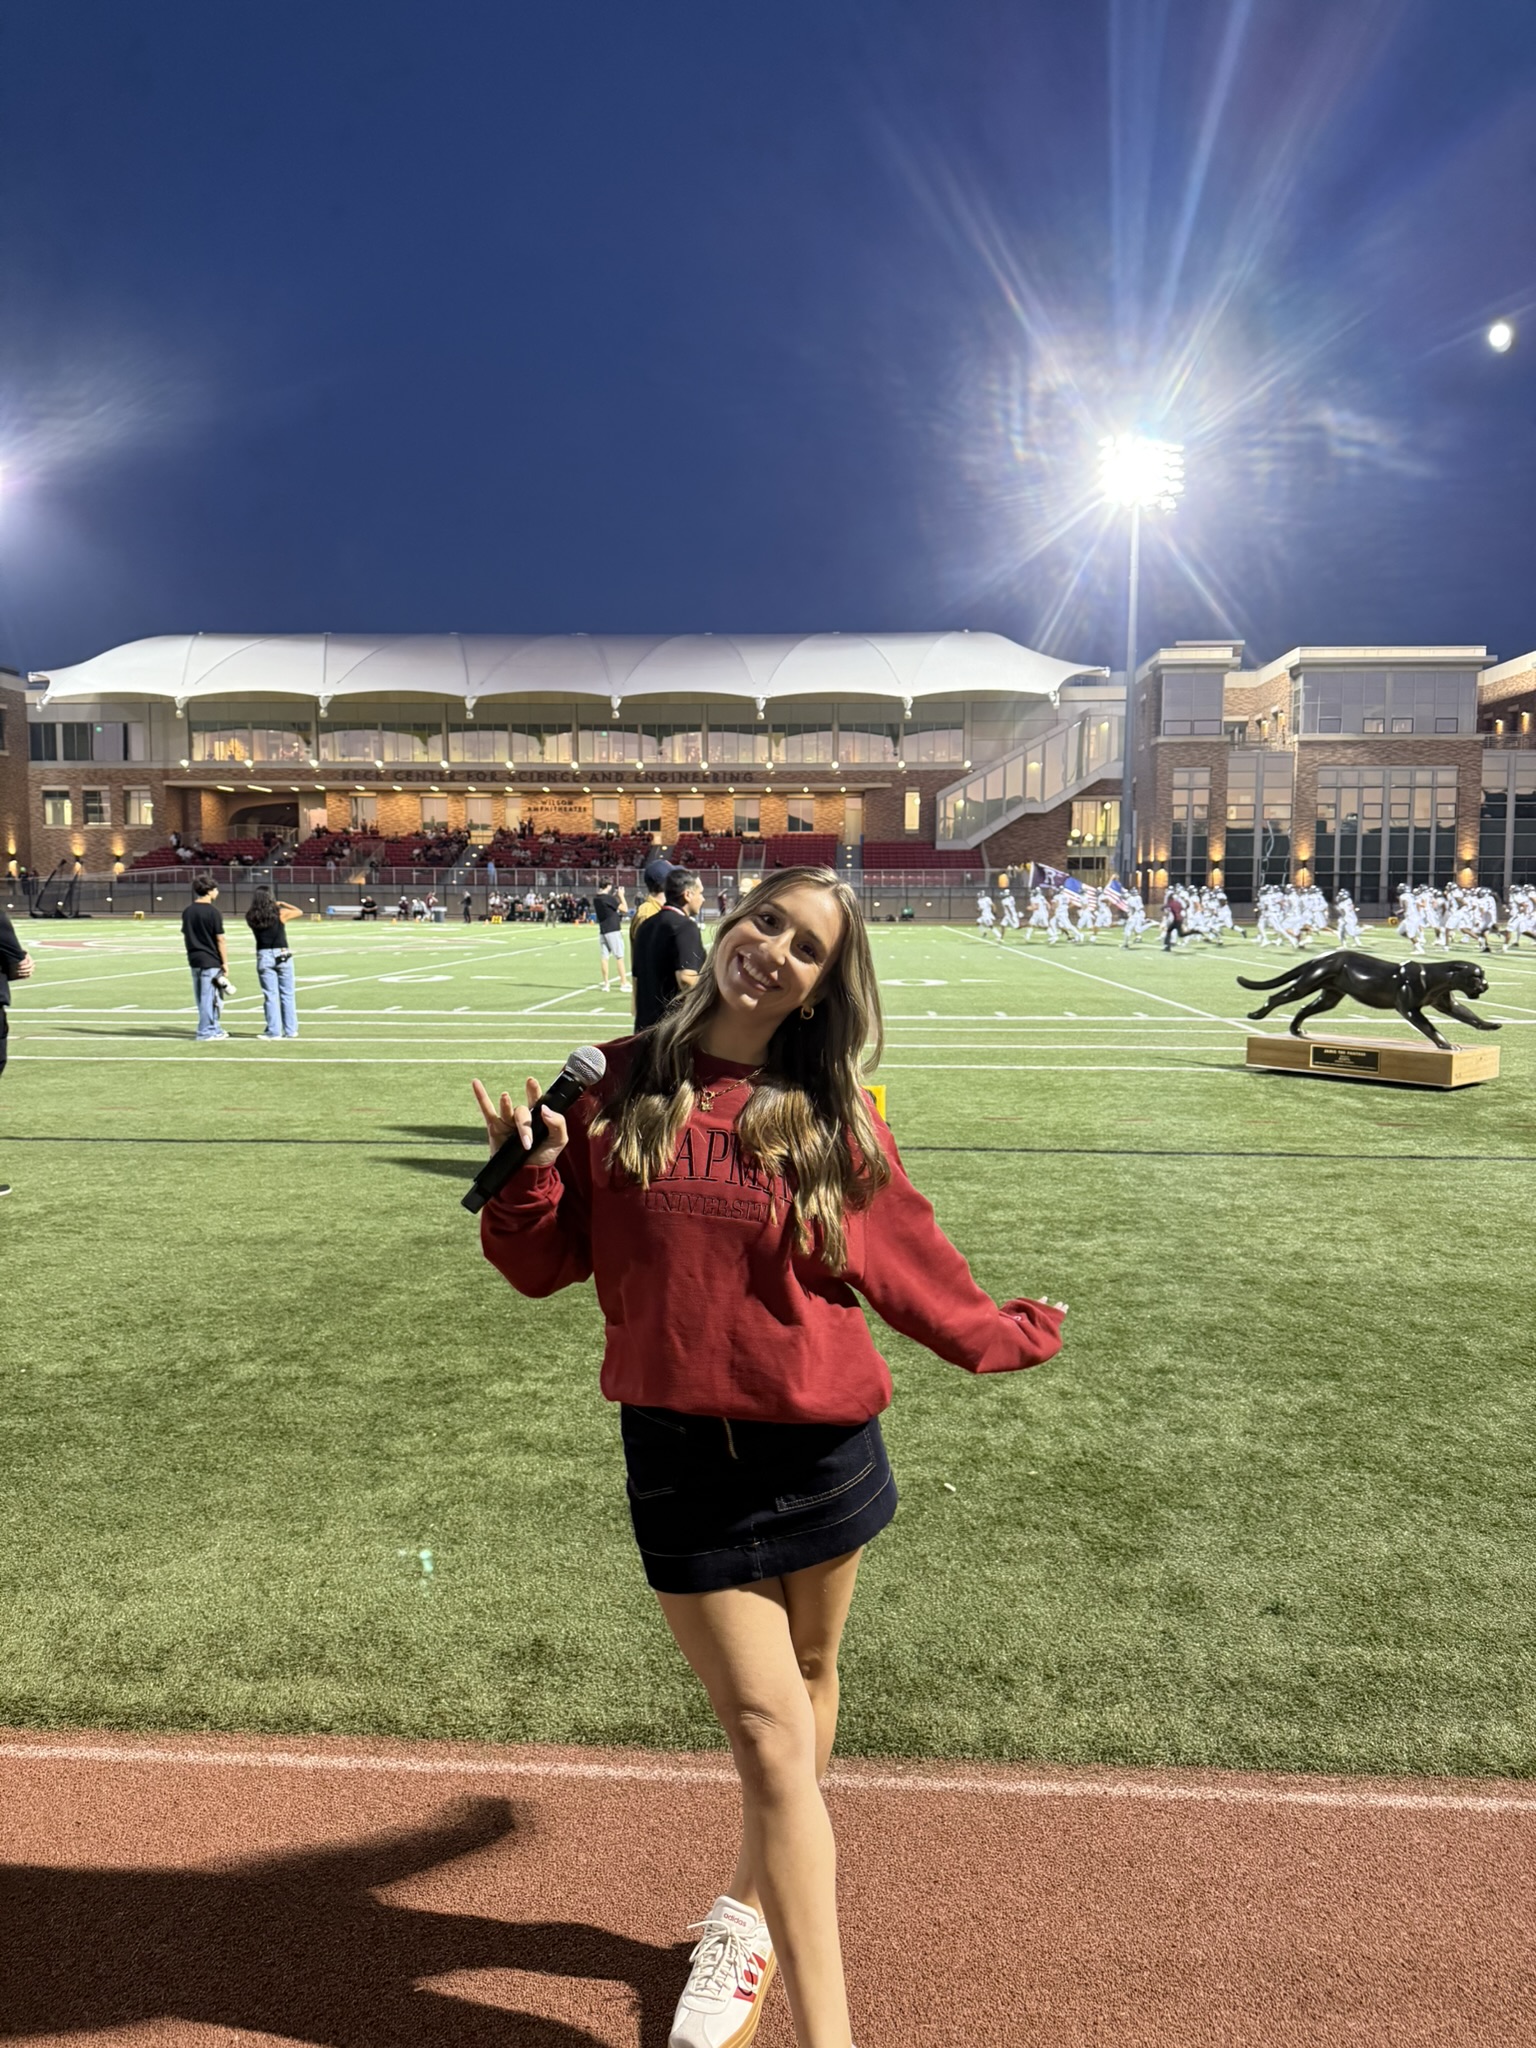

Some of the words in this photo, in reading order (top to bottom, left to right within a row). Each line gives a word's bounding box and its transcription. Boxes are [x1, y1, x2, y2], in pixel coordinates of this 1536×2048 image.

[341, 769, 383, 781] KECK
[394, 769, 455, 782] CENTER
[467, 769, 497, 782] FOR
[507, 770, 581, 783] SCIENCE
[588, 770, 624, 783] AND
[634, 770, 754, 783] ENGINEERING
[645, 1190, 772, 1222] UNIVERSIT
[724, 1913, 746, 1927] adidas
